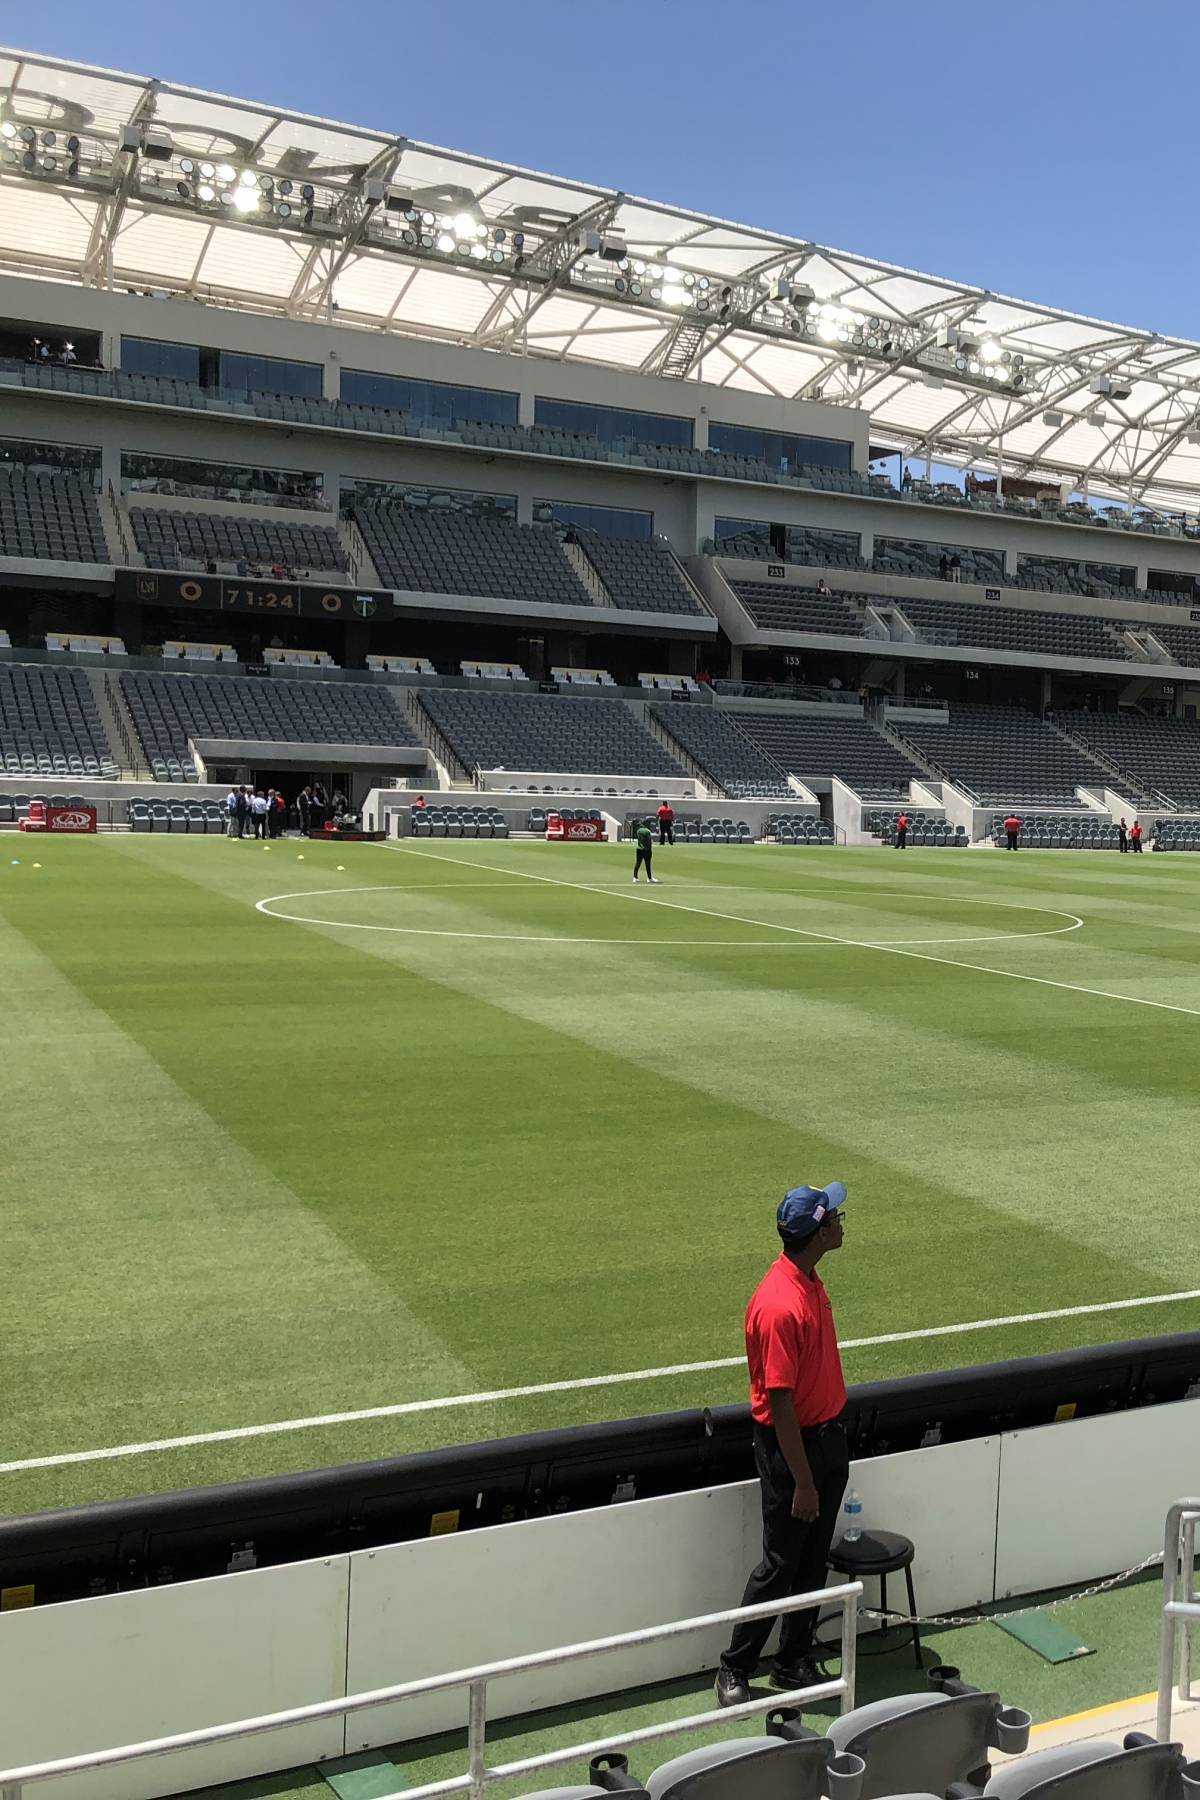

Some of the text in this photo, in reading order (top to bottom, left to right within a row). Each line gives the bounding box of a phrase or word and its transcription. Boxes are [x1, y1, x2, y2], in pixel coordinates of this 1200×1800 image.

[769, 567, 784, 577] 233
[226, 589, 294, 609] 71:24
[785, 656, 800, 666] 133
